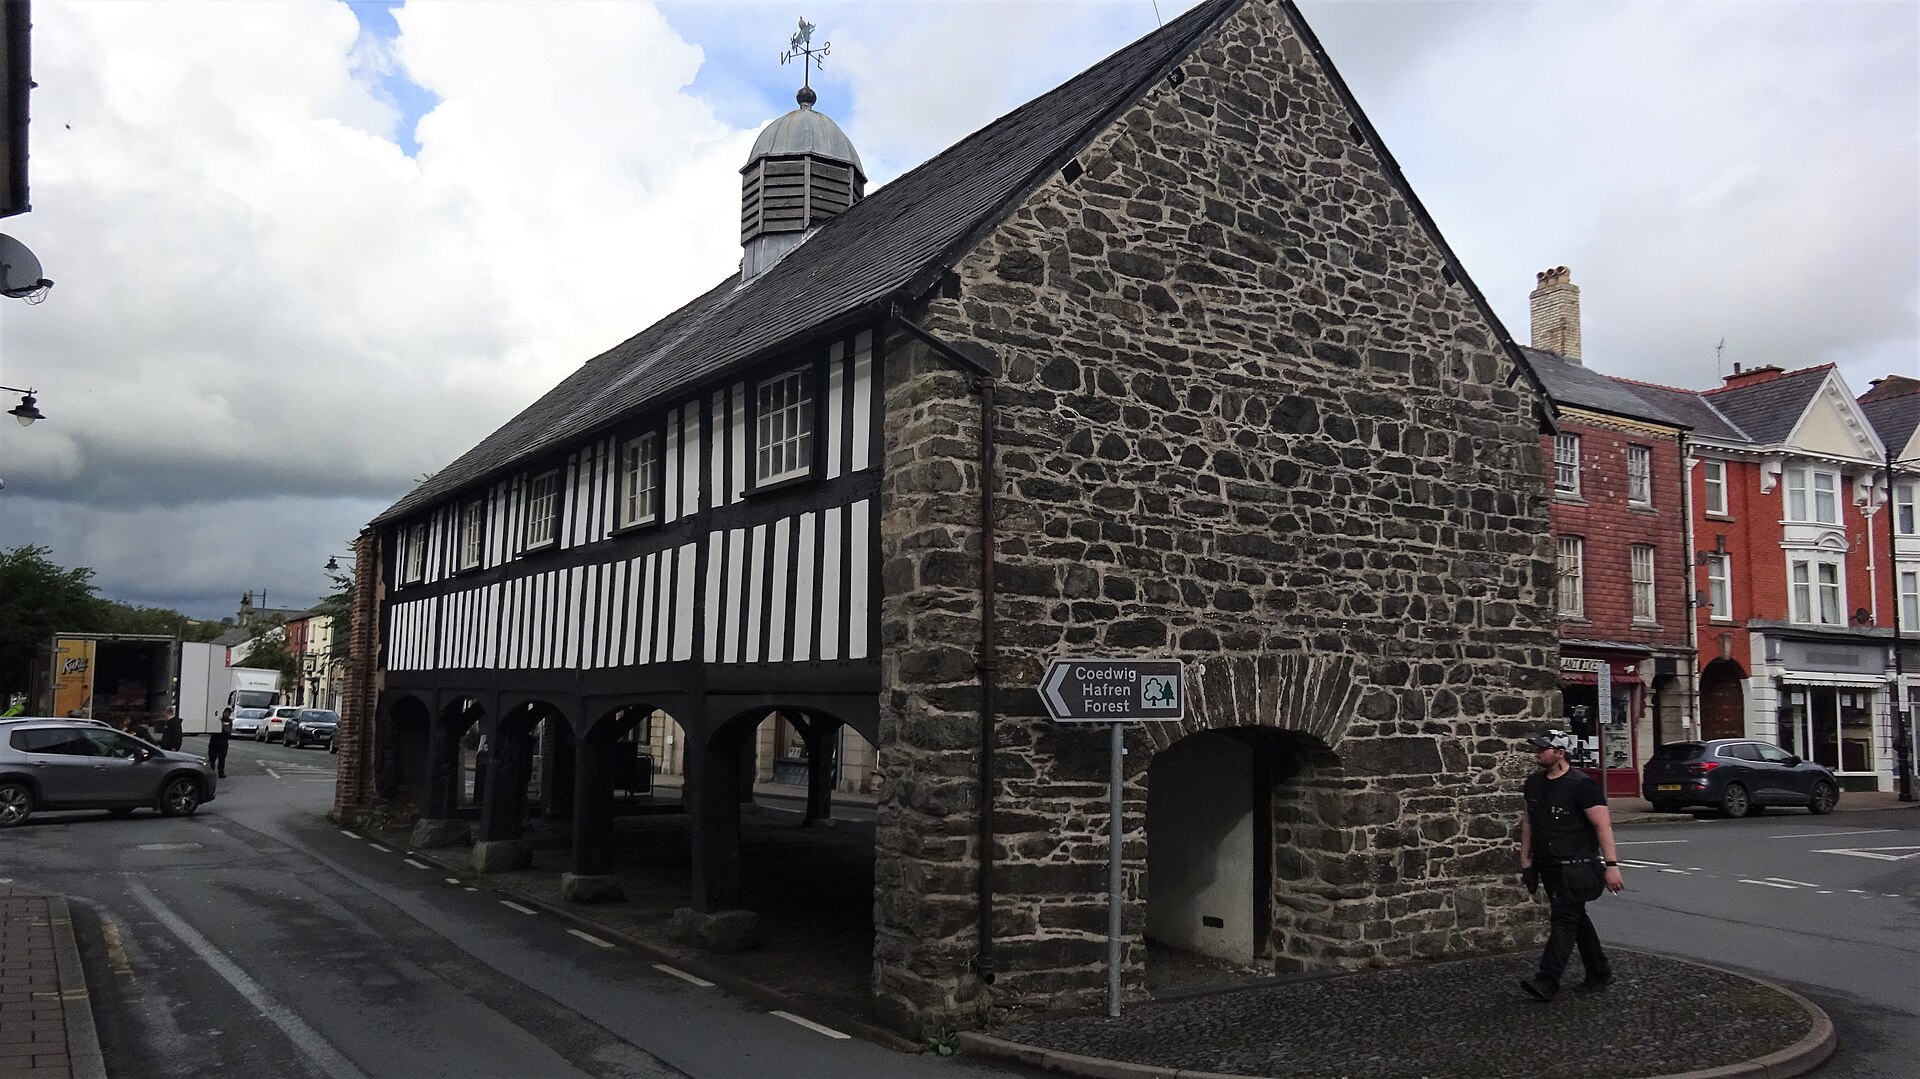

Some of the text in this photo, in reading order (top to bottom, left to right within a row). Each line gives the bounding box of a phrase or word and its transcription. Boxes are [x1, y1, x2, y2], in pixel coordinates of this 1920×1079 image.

[1075, 666, 1137, 683] Coedwig
[1082, 683, 1131, 696] Hafren
[1084, 699, 1130, 713] Forest
